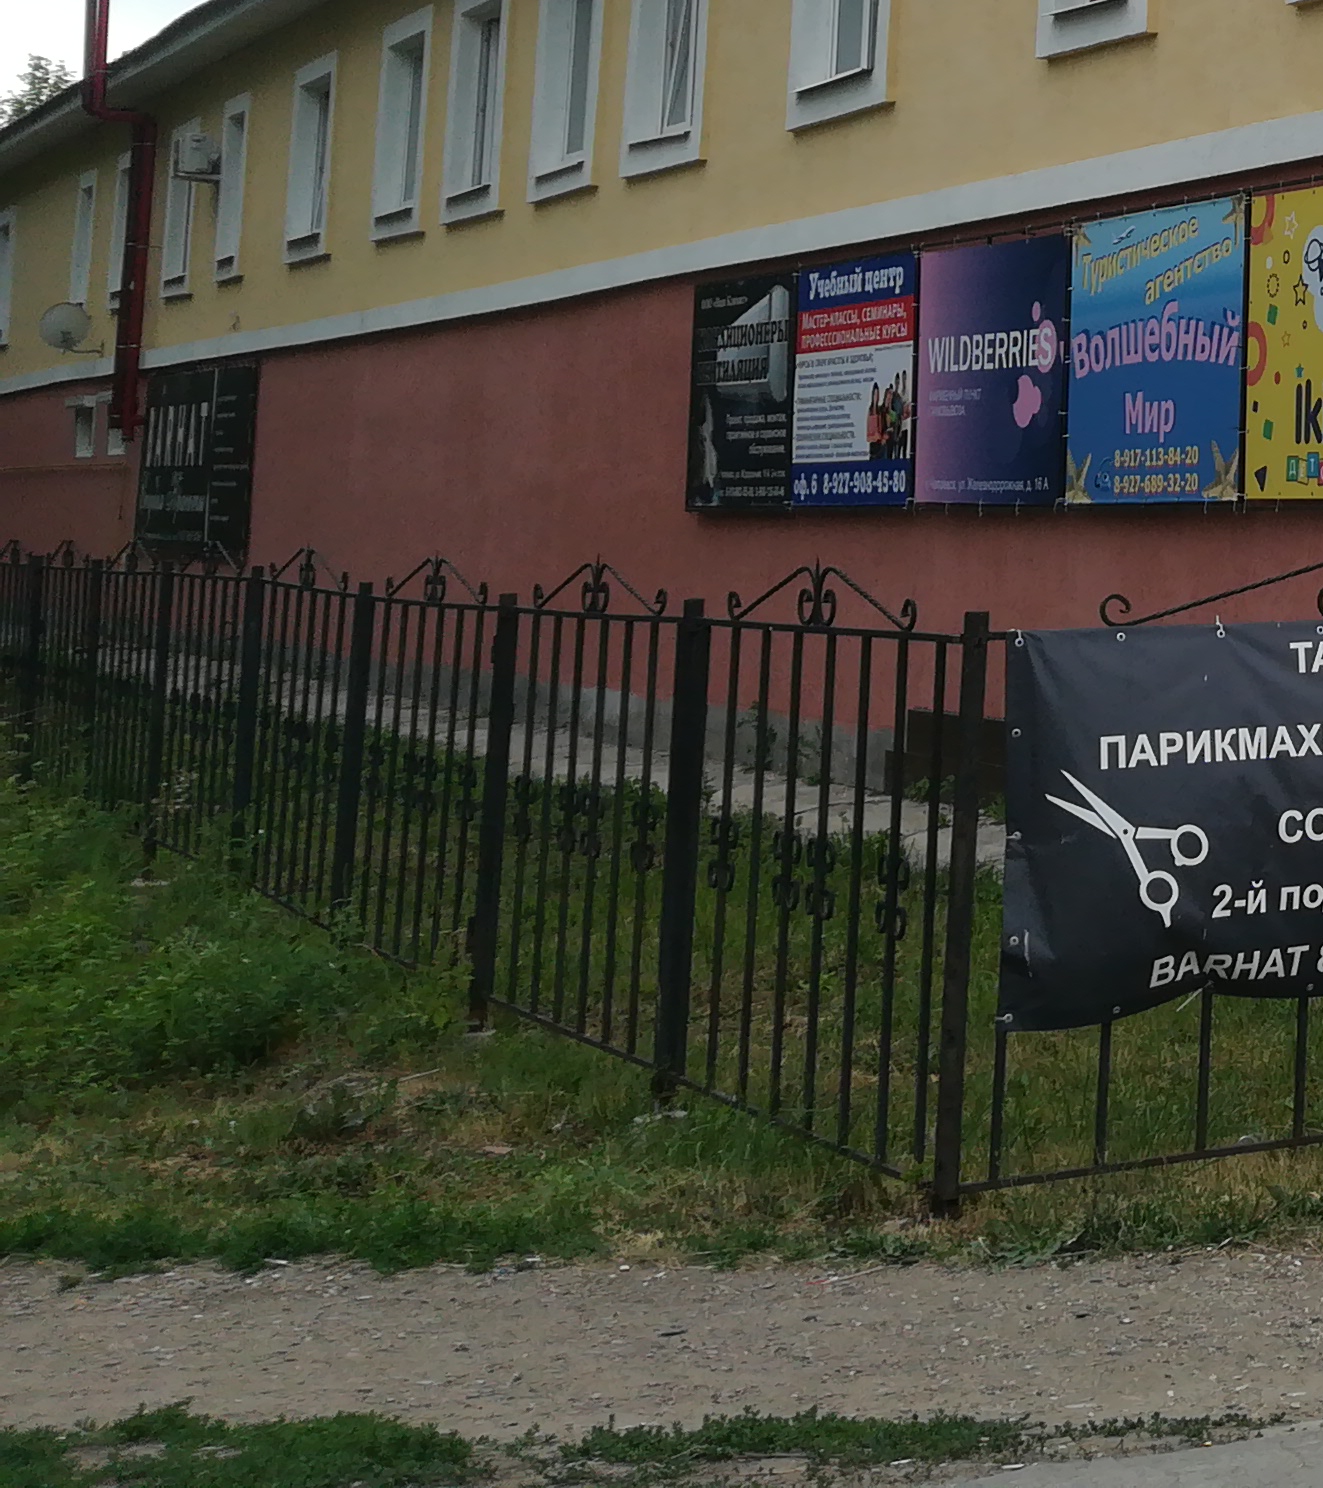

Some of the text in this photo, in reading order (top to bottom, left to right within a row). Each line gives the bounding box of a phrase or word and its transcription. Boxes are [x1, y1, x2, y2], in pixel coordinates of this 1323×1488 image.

[1082, 216, 1198, 296] Туристическое
[1145, 237, 1232, 305] агентство
[809, 266, 904, 300] Учебный центр
[928, 327, 1052, 374] WILDBERRIES
[1071, 299, 1241, 379] Волшебный
[1124, 391, 1174, 443] Мир
[1212, 880, 1268, 918] 2-й
[1149, 944, 1309, 989] BARHAT
